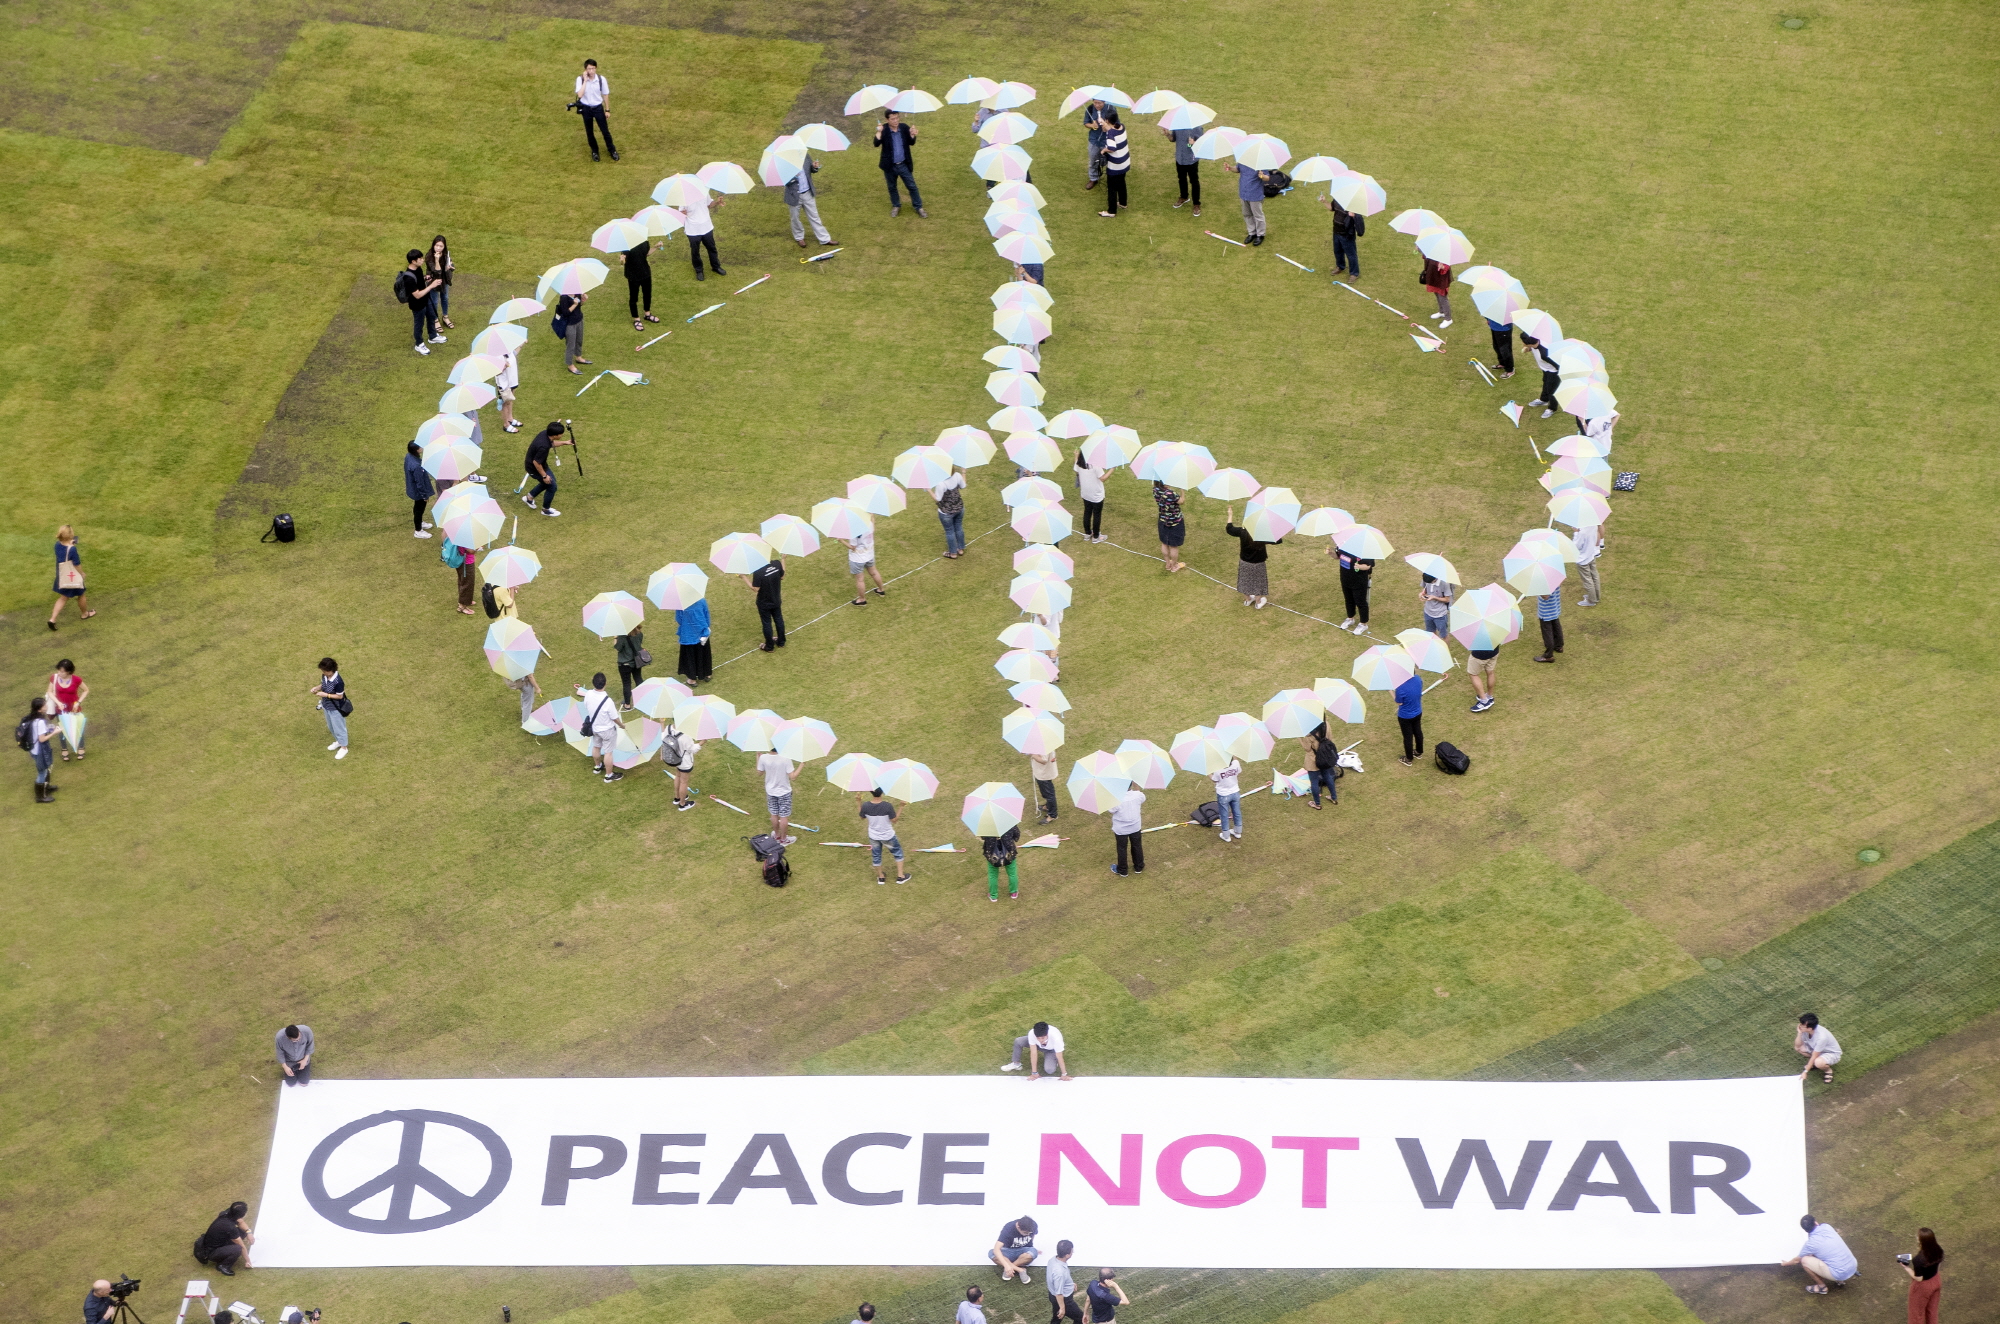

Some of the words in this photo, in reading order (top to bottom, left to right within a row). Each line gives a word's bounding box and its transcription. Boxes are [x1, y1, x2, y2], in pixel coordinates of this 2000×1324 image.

[541, 1133, 989, 1206] PEACE
[1037, 1134, 1359, 1208] NOT
[1395, 1138, 1764, 1215] WAR
